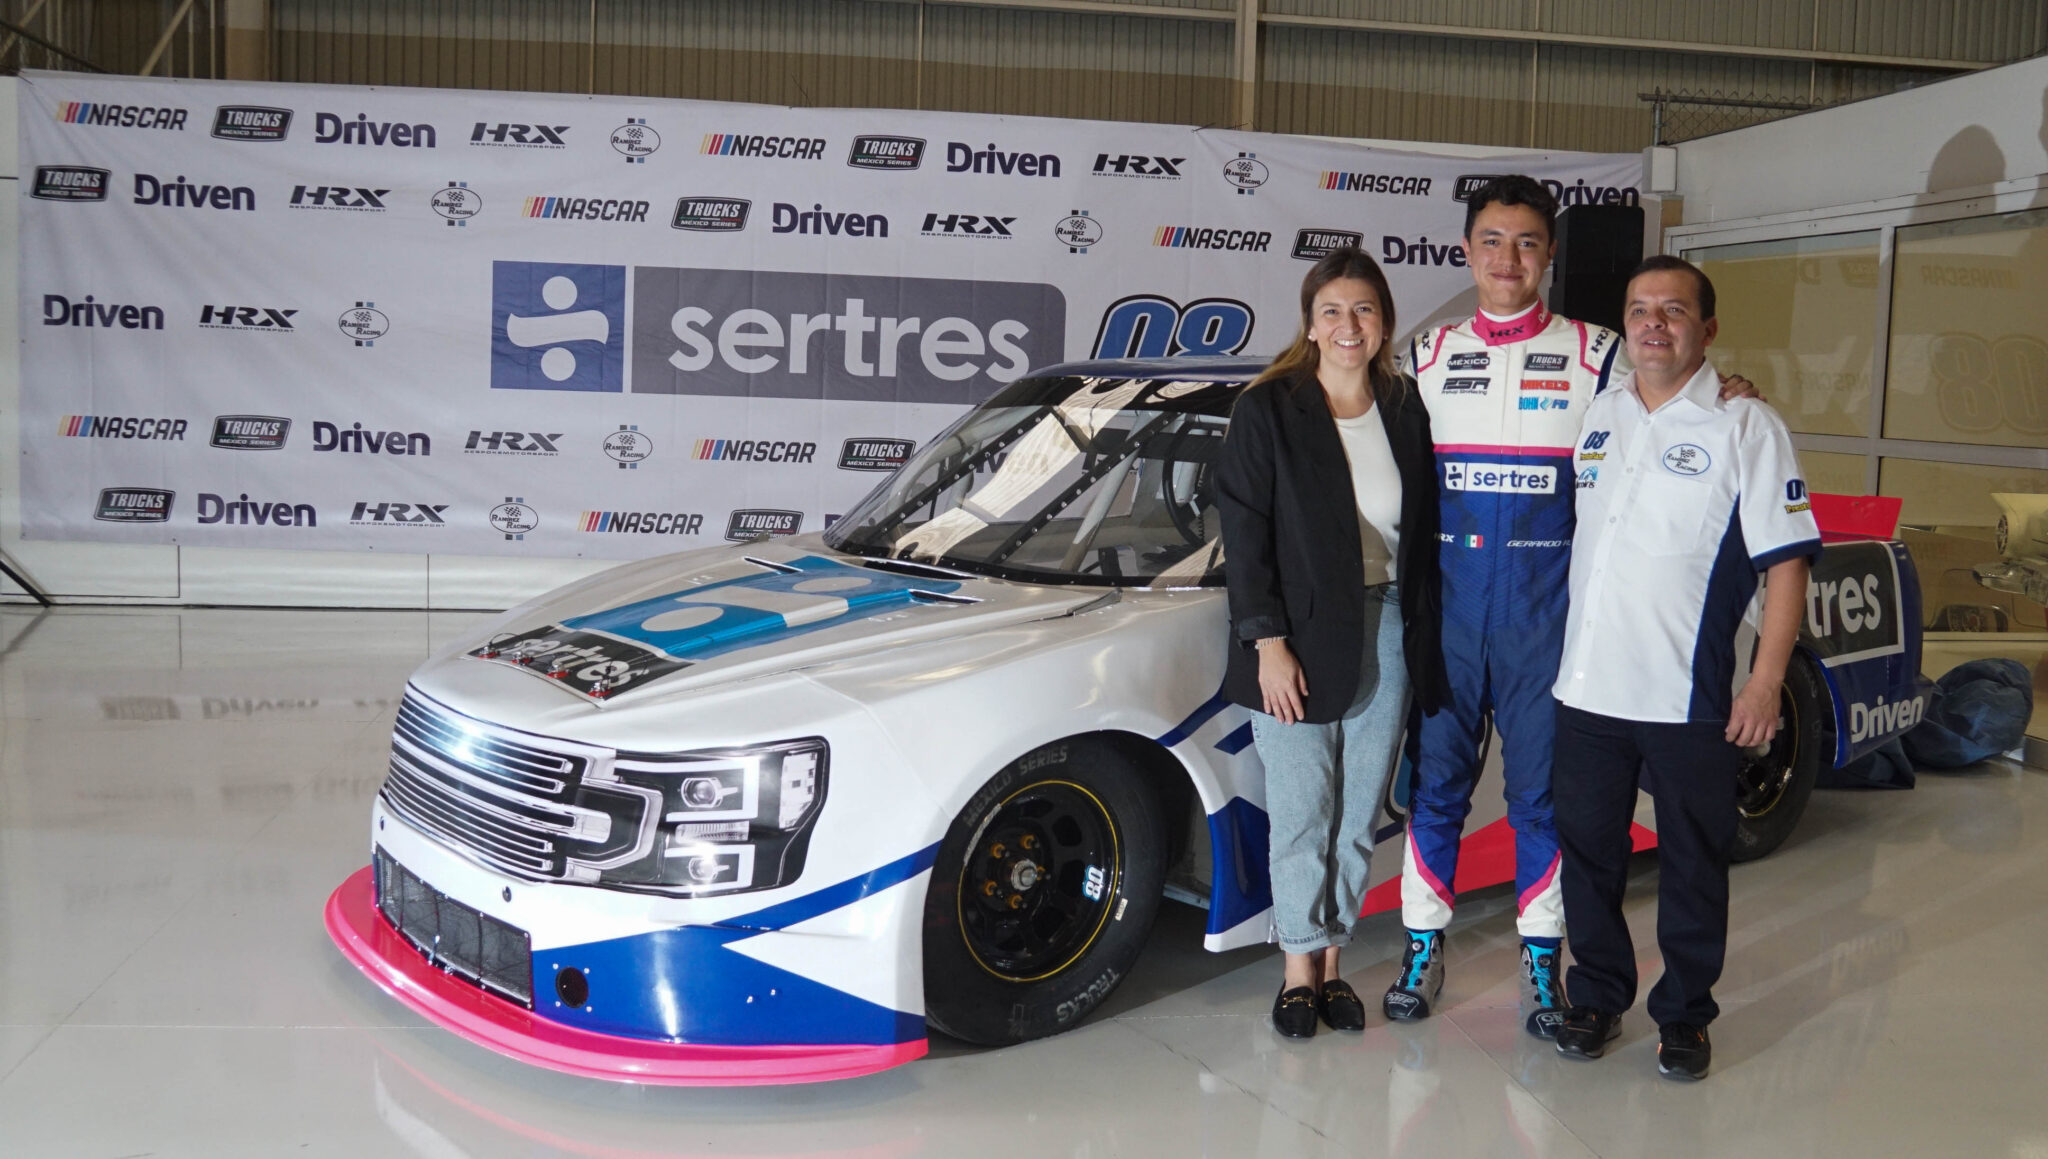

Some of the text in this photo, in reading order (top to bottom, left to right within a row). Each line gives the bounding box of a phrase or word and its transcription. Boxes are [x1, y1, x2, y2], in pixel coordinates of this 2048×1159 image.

[88, 103, 188, 131] NASCAR
[226, 111, 282, 127] TRUCKS
[315, 113, 436, 148] Driven
[470, 123, 570, 144] HRX
[627, 144, 652, 153] RACING
[733, 135, 826, 160] NASCAR
[862, 140, 915, 156] TRUCKS
[946, 142, 1061, 177] Driven
[1093, 154, 1186, 176] HRX
[44, 171, 101, 187] TRUCKS
[1239, 176, 1261, 185] RACING
[1345, 173, 1431, 196] NASCAR
[134, 174, 256, 211] Driven
[290, 186, 391, 208] HRX
[1541, 178, 1639, 206] Driven
[448, 207, 473, 215] RACING
[552, 198, 649, 223] NASCAR
[686, 202, 741, 218] TRUCKS
[772, 203, 889, 238] Driven
[711, 220, 737, 228] SERIES
[921, 213, 1018, 235] HRX
[1071, 235, 1095, 243] RACING
[1181, 228, 1271, 253] NASCAR
[1305, 233, 1353, 248] TRUCKS
[1383, 236, 1470, 267] Drive
[43, 294, 164, 330] Driven
[200, 305, 298, 328] HRX
[356, 328, 381, 336] RACING
[1090, 294, 1256, 357] 08
[1489, 325, 1524, 338] HRX
[668, 298, 1030, 383] sertres
[1591, 328, 1610, 354] HRX
[1532, 356, 1564, 365] TRUCKS
[91, 416, 187, 441] NASCAR
[224, 420, 280, 436] TRUCKS
[312, 421, 431, 456] Driven
[465, 431, 564, 452] HRX
[852, 442, 905, 457] TRUCKS
[1583, 431, 1610, 450] 08
[619, 450, 644, 459] RACING
[720, 440, 816, 464] NASCAR
[875, 460, 901, 468] SERIES
[1473, 470, 1549, 489] sertres
[109, 493, 166, 509] TRUCKS
[198, 493, 317, 528] Driven
[350, 502, 450, 523] HRX
[607, 512, 703, 535] NASCAR
[739, 514, 793, 529] TRUCKS
[506, 521, 531, 530] RACING
[1506, 539, 1562, 547] GERARDO
[1805, 572, 1882, 639] tres
[1850, 695, 1924, 744] Driven
[1019, 745, 1069, 776] SERIES
[1056, 967, 1120, 1023] TRUCKS
